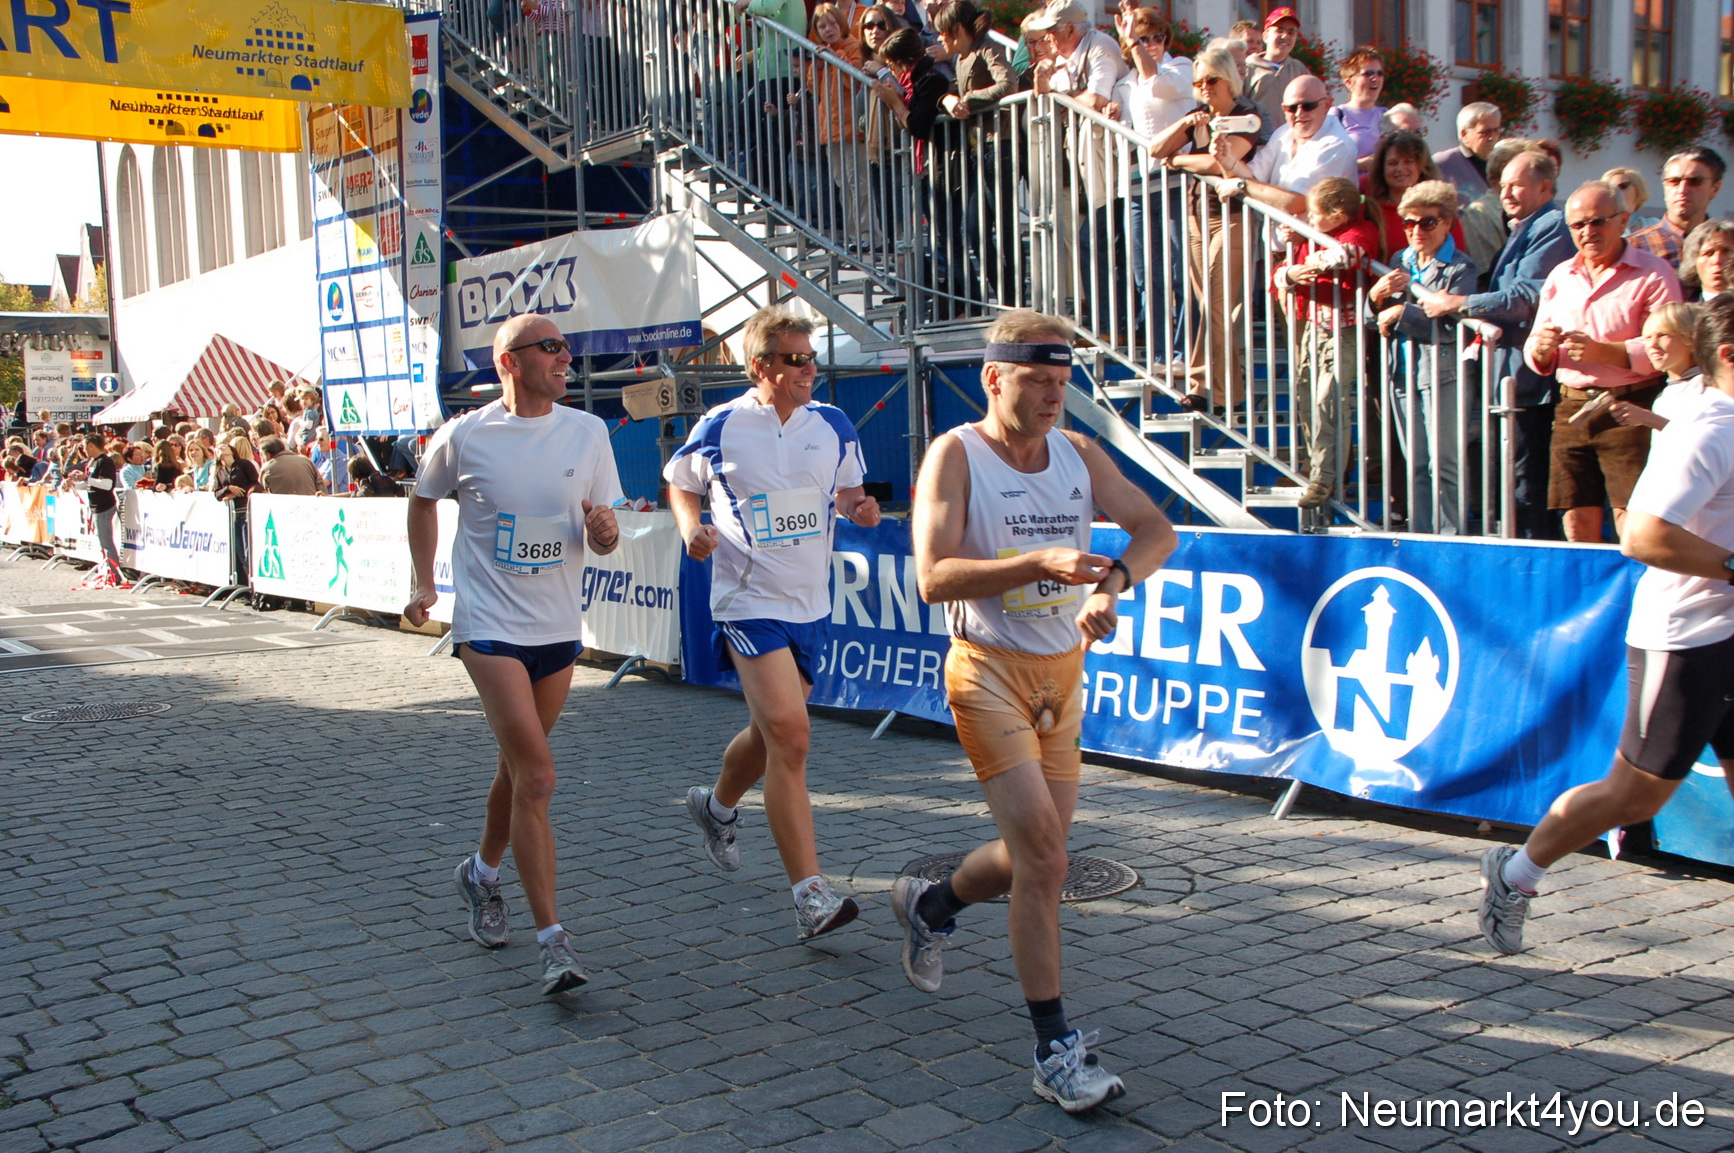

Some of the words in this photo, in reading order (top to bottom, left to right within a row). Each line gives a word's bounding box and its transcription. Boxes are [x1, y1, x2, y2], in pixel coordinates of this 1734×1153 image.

[0, 0, 131, 63] RT
[192, 44, 289, 65] Neumarkter
[294, 54, 365, 73] Stadtlauf
[109, 98, 196, 117] Neumarkter
[201, 105, 265, 121] Stadtlauf
[346, 170, 374, 190] MERZ
[458, 256, 578, 329] BOCK
[775, 512, 817, 532] 3690
[1005, 514, 1027, 525] LLC
[517, 541, 562, 559] 3688
